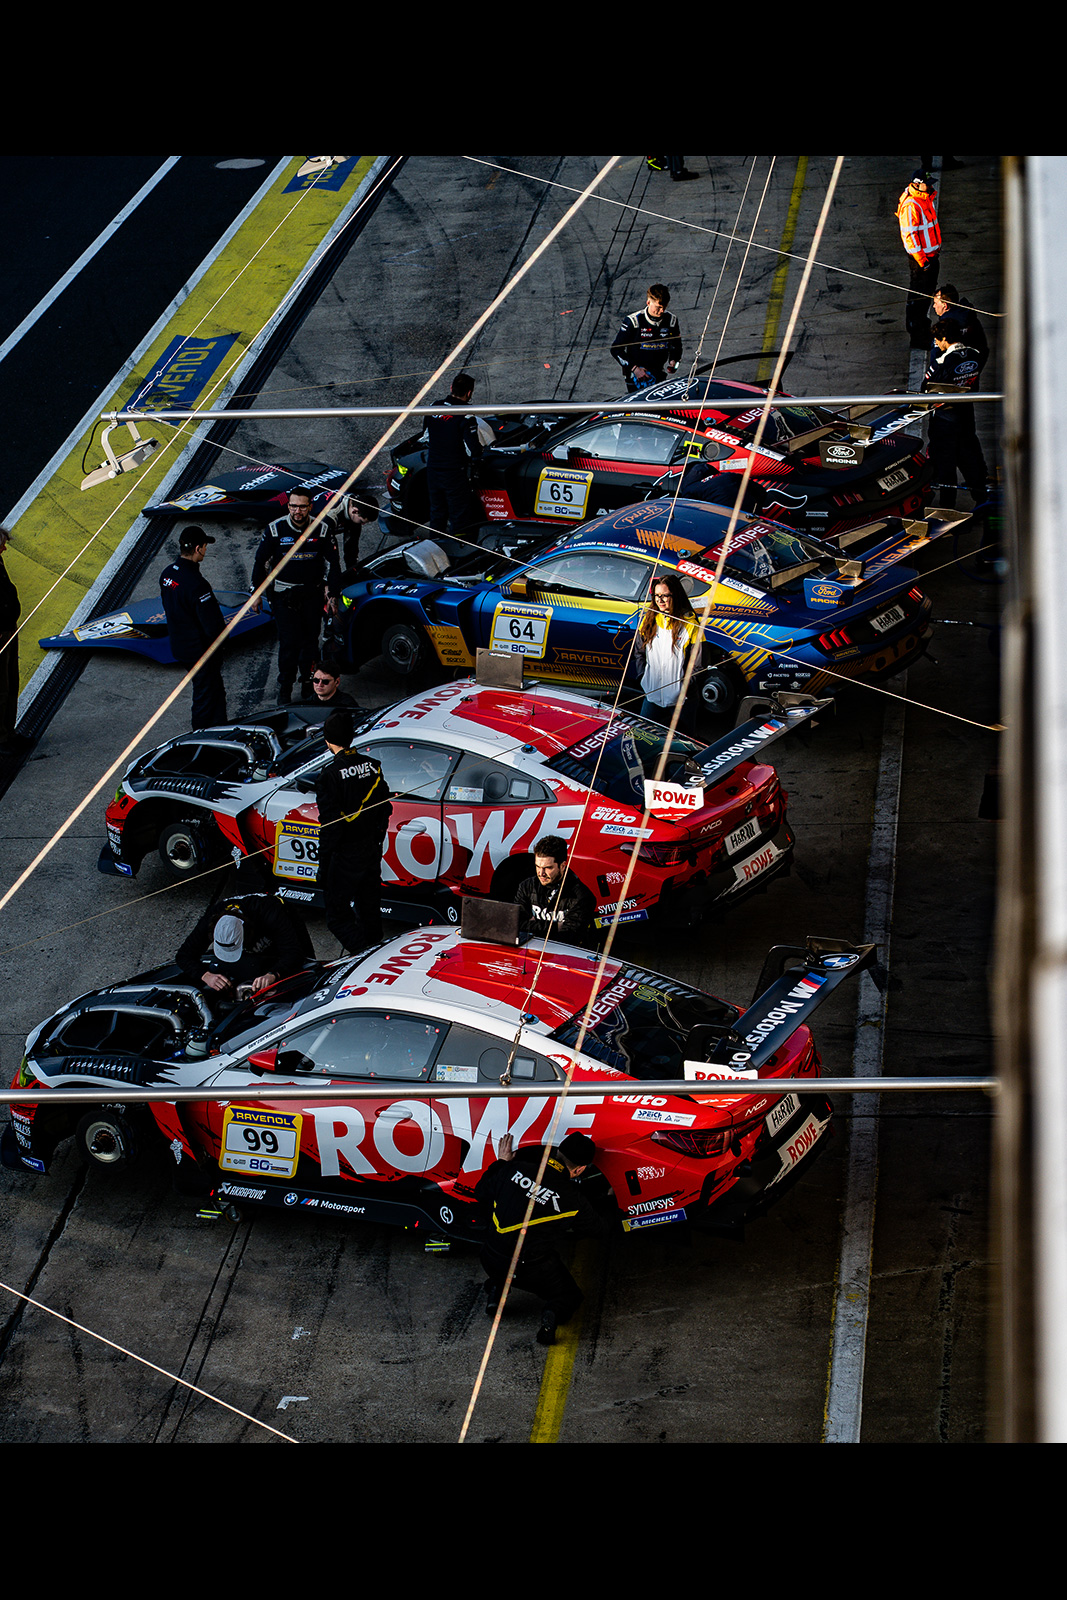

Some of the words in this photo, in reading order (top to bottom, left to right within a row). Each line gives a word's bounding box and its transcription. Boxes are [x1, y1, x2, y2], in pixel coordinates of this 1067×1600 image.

[705, 430, 740, 445] auto
[548, 472, 585, 481] RAVENOL
[550, 483, 573, 502] 65
[678, 564, 716, 582] auto
[504, 606, 544, 617] RAVENOL
[716, 605, 764, 616] RAVENOL
[509, 619, 535, 641] 64
[560, 651, 617, 666] RAVENOL
[398, 682, 478, 720] ROWE
[569, 721, 630, 758] WEMPE
[338, 761, 371, 780] ROWE
[653, 789, 697, 806] ROWE
[590, 811, 637, 824] auto
[290, 839, 320, 861] 98
[742, 848, 774, 881] ROWE
[364, 933, 452, 986] ROWE
[577, 977, 637, 1028] WEMPE
[235, 1111, 291, 1126] RAVENOL
[243, 1128, 279, 1153] 99
[302, 1096, 606, 1177] ROWE
[786, 1122, 818, 1165] ROWE
[510, 1170, 555, 1202] ROWE
[319, 1200, 366, 1214] Motorsport
[641, 1213, 679, 1226] MICHELIN
